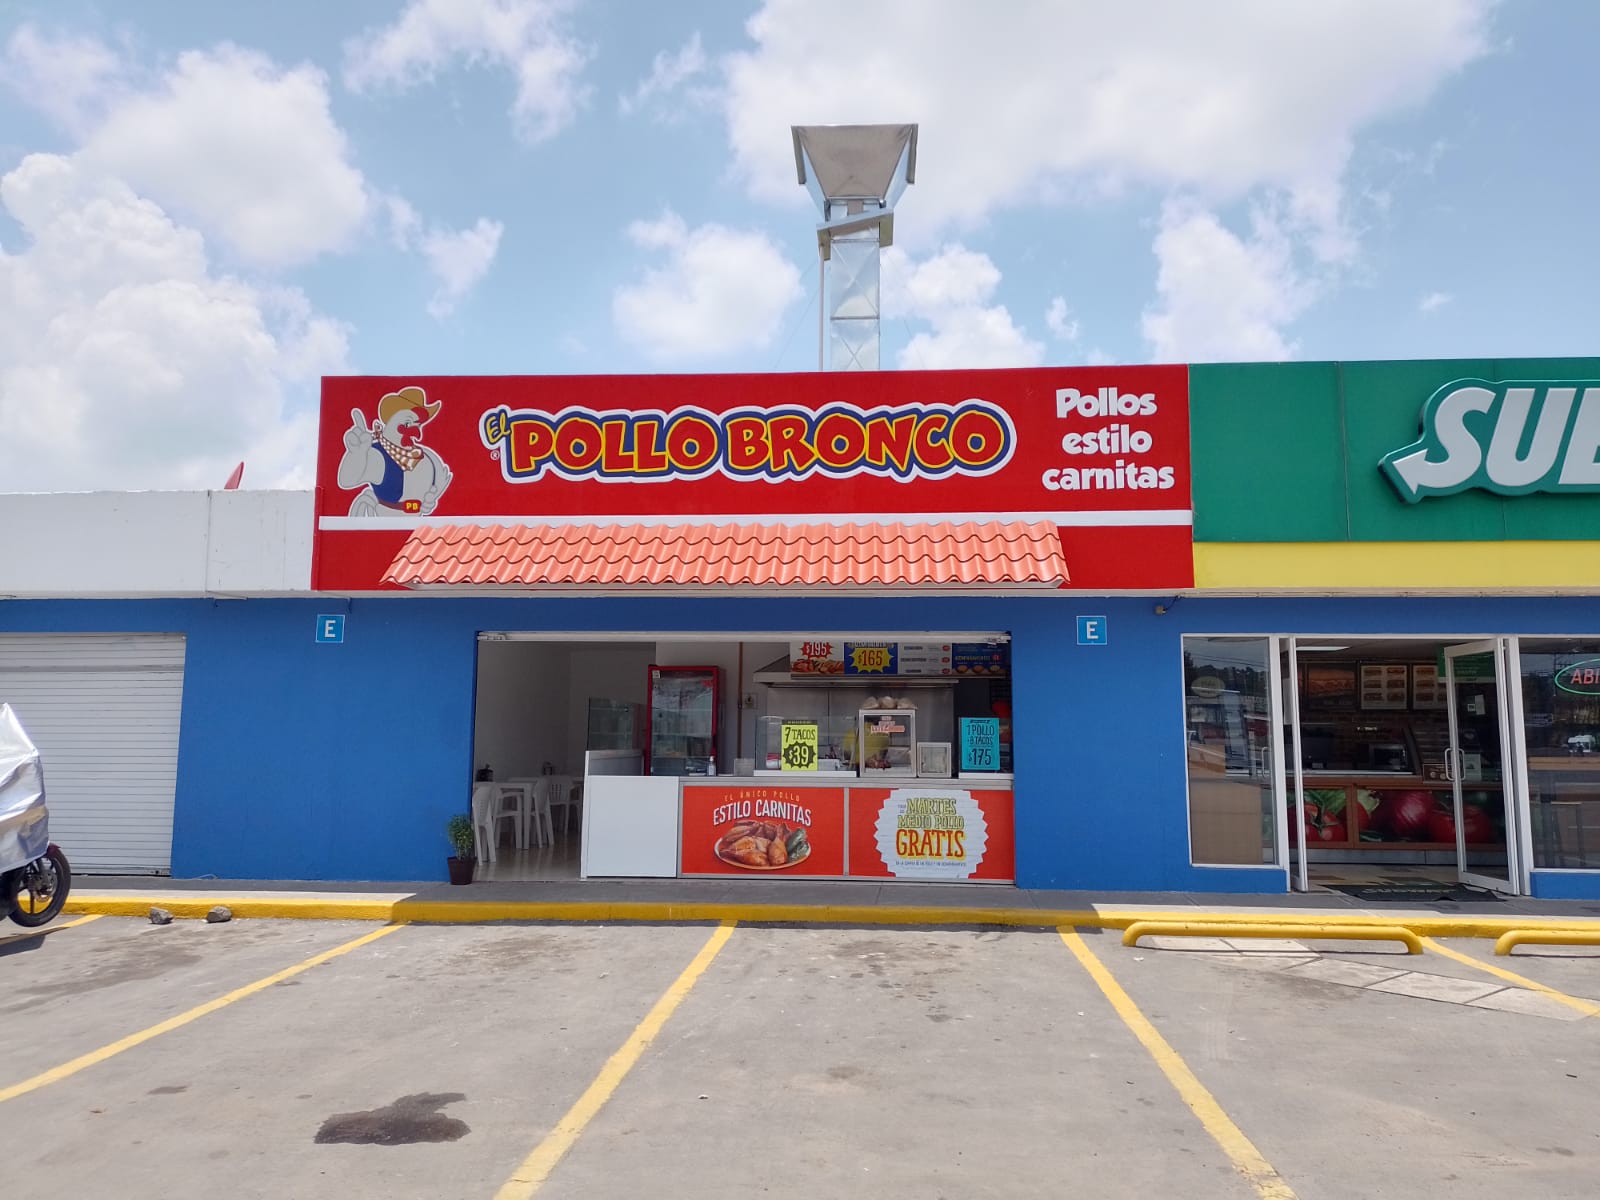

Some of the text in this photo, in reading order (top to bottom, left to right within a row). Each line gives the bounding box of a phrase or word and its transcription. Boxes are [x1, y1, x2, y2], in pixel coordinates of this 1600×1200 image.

[1055, 387, 1157, 419] Pollos
[486, 410, 1005, 473] El POLLO BRONCO
[1062, 424, 1153, 455] estilo
[1041, 459, 1175, 491] carnitas
[406, 502, 418, 510] PB
[325, 620, 336, 638] E
[1086, 621, 1098, 640] E
[805, 641, 827, 657] $195
[858, 650, 883, 666] $165
[785, 727, 816, 743] 7 TACOS
[971, 724, 995, 736] POLLO
[788, 745, 809, 765] $39
[968, 747, 992, 766] $175
[724, 793, 734, 802] EL
[773, 790, 800, 802] POLLO
[713, 799, 812, 827] ESTILO CARNITAS
[906, 798, 957, 815] MARTES
[934, 815, 965, 830] POLLO
[896, 829, 965, 858] GRATIS
